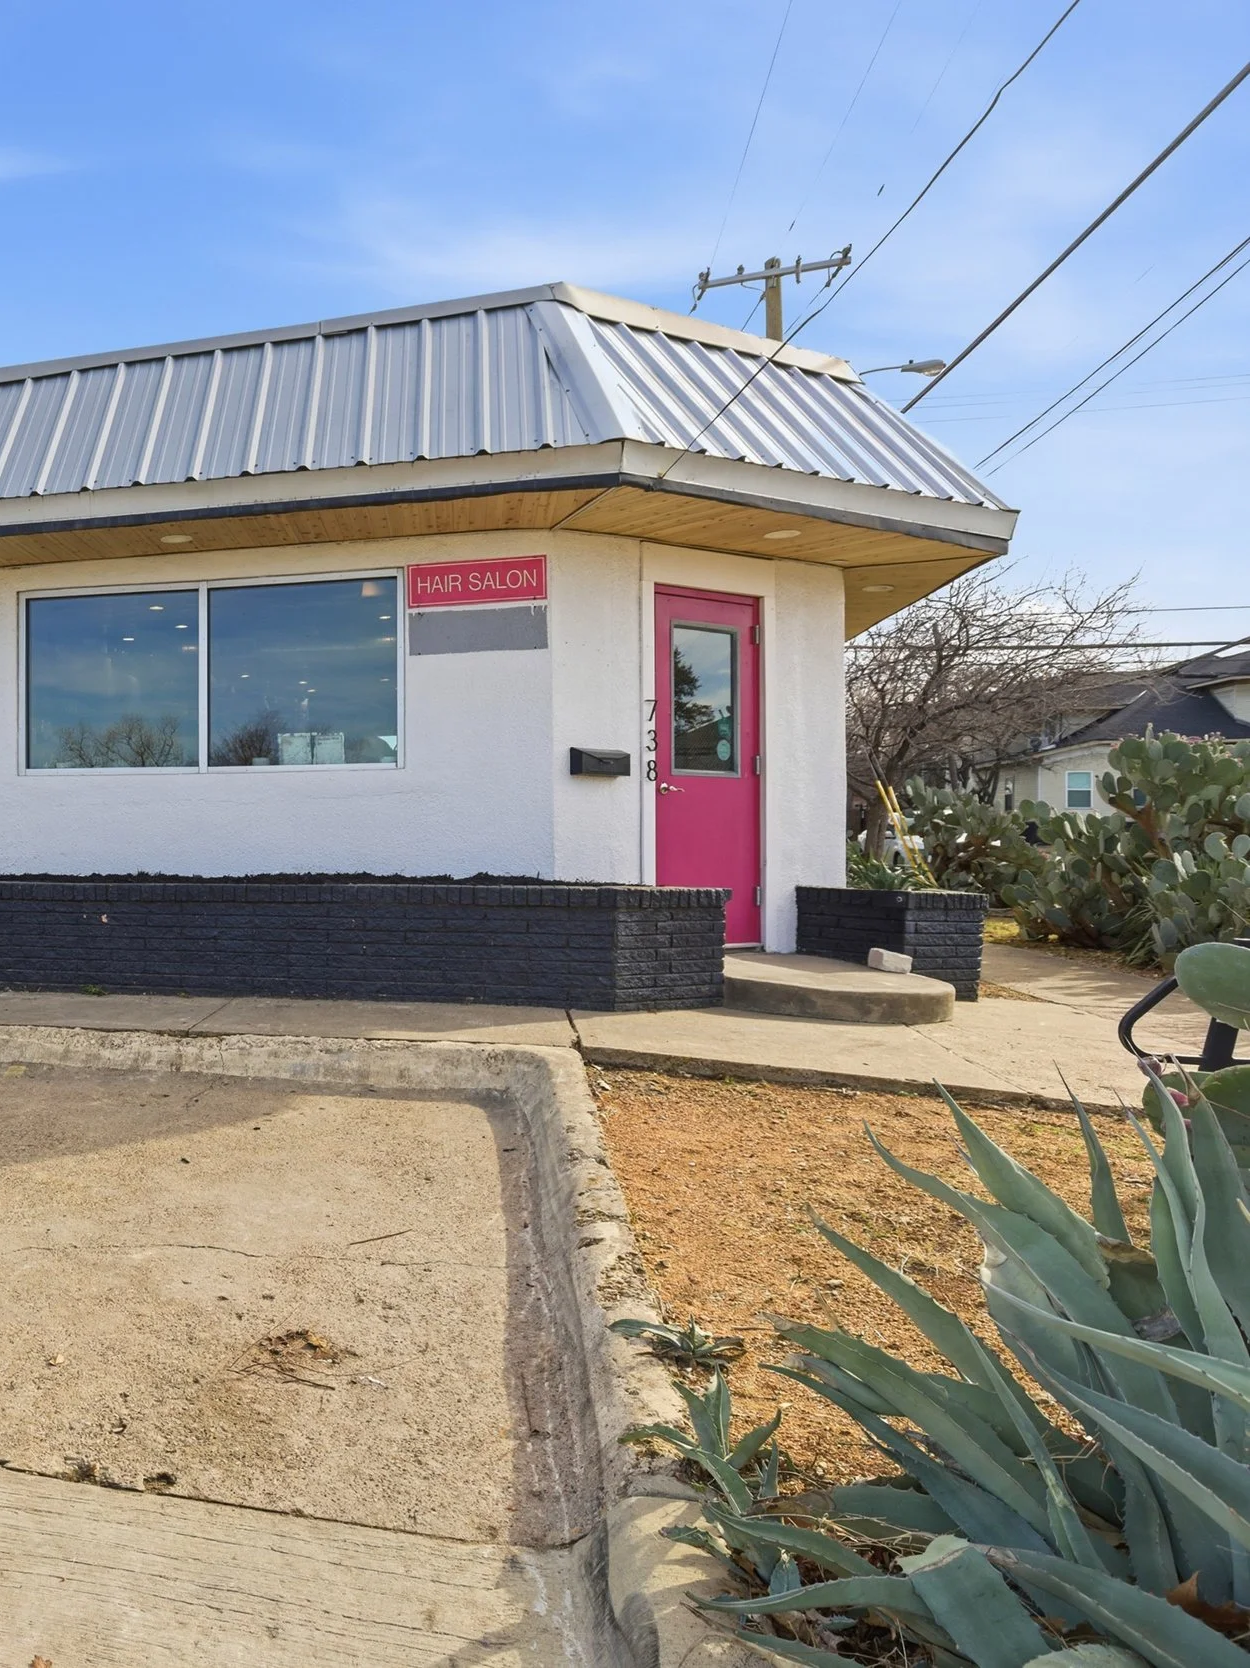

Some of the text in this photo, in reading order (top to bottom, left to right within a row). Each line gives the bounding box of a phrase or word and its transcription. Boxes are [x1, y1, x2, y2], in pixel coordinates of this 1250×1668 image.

[417, 569, 537, 594] HAIR SALON
[644, 699, 658, 781] 738
